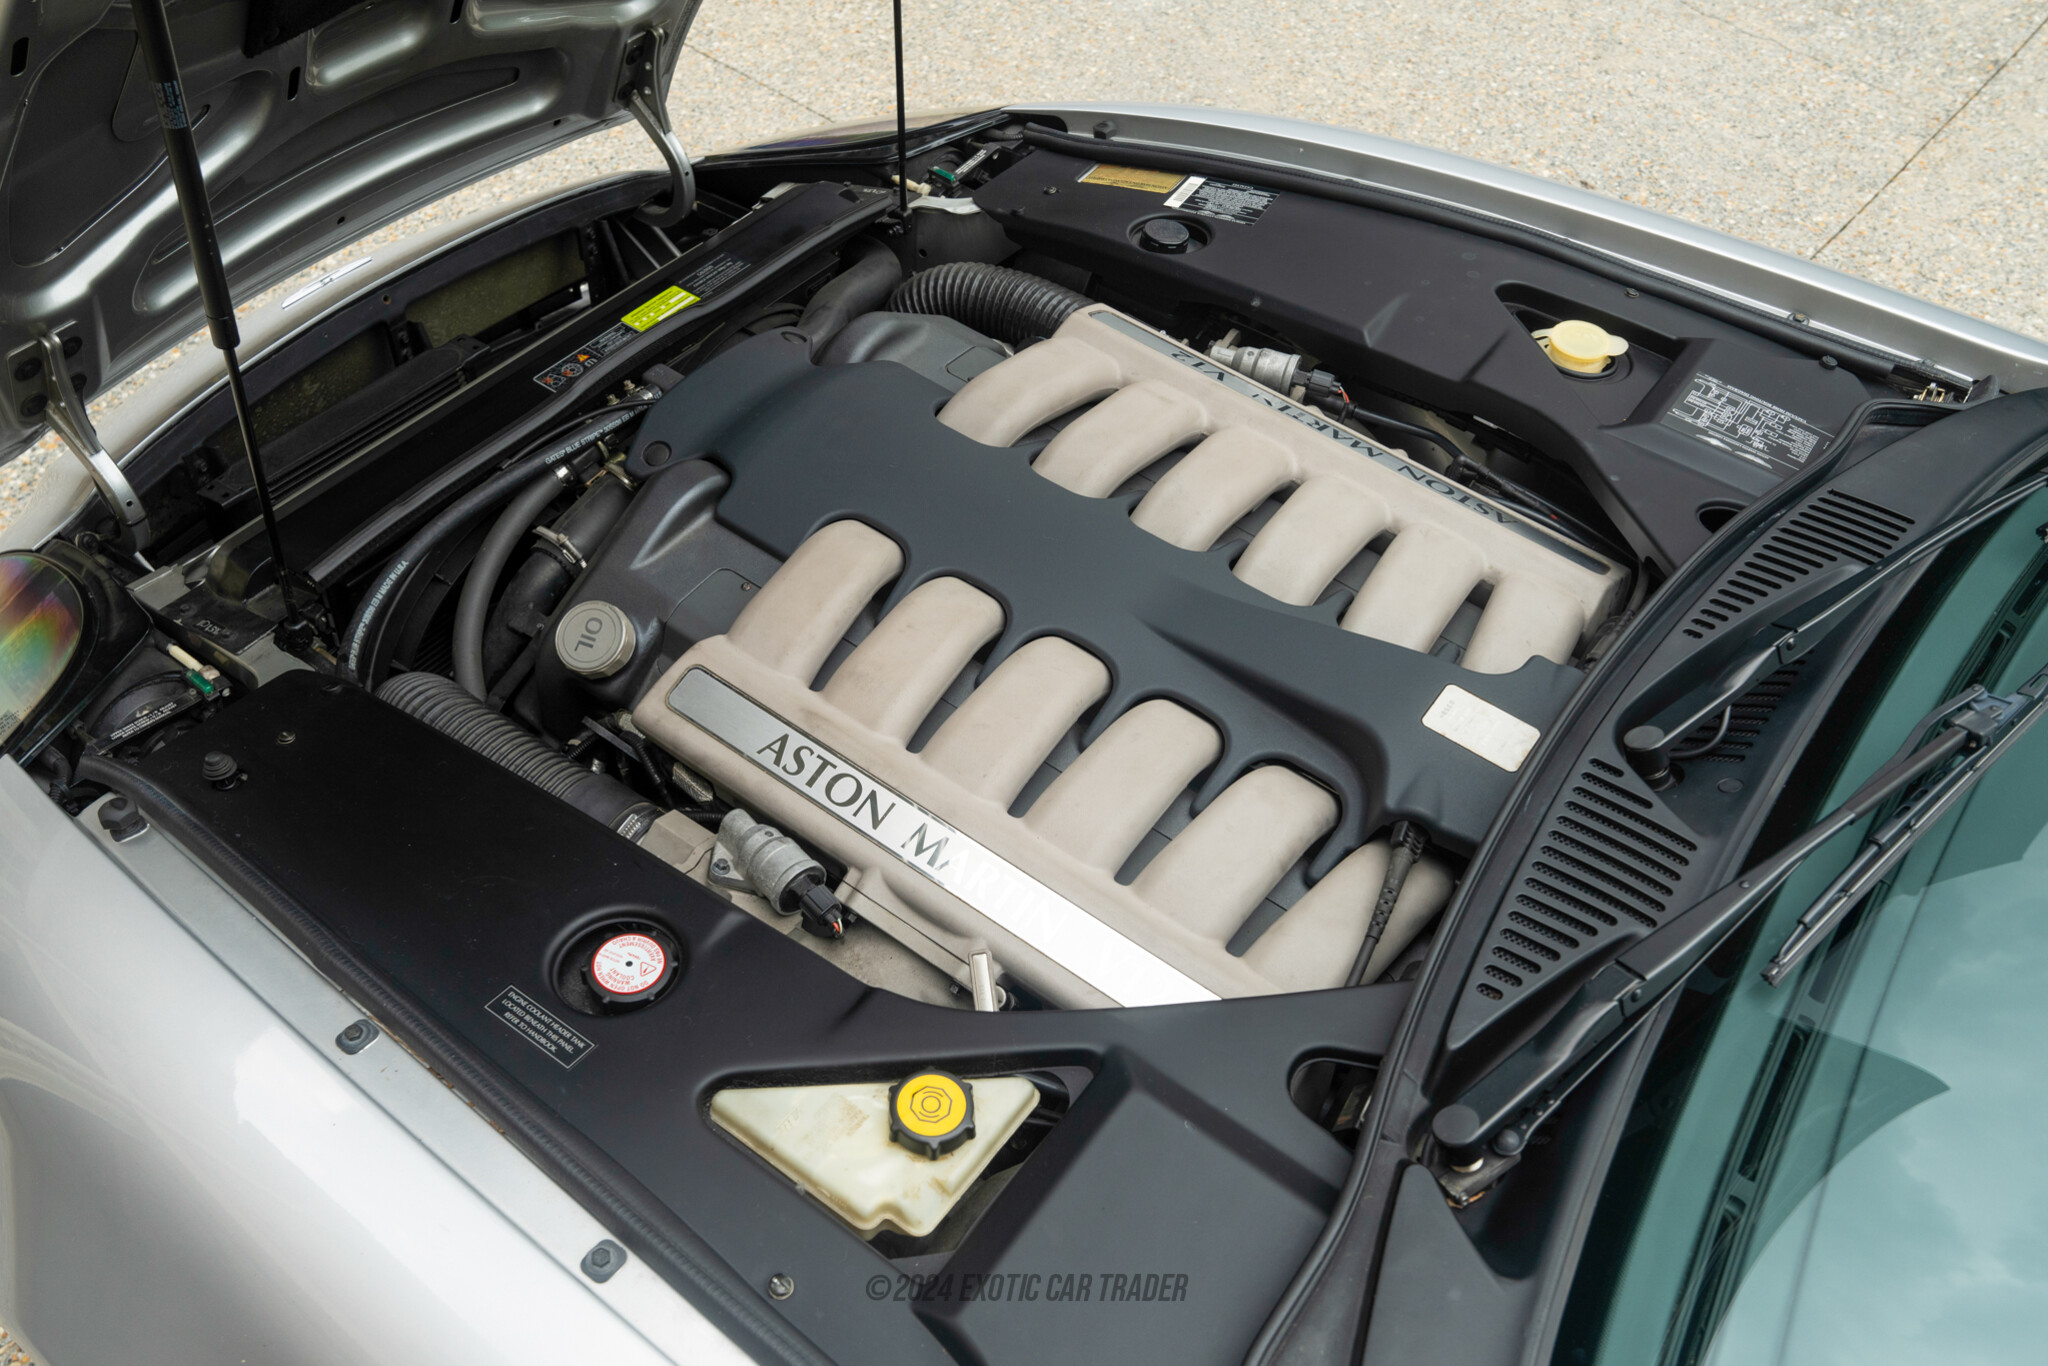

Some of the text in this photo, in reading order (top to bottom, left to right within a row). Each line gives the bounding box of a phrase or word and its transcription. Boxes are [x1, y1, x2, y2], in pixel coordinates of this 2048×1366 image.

[565, 440, 581, 453] BLUE
[1173, 350, 1518, 524] ASTON MARTIN V12
[378, 576, 393, 594] MADE
[574, 617, 603, 652] OIL
[757, 733, 896, 830] ASTON
[605, 971, 630, 984] WARNING
[609, 967, 634, 980] COOLANT
[501, 999, 525, 1016] LOCATED
[523, 1014, 547, 1032] BENEATH
[546, 1030, 558, 1040] THIS
[503, 1011, 519, 1024] REFER
[507, 991, 586, 1048] ENGINE COOLANT HEADER TANK
